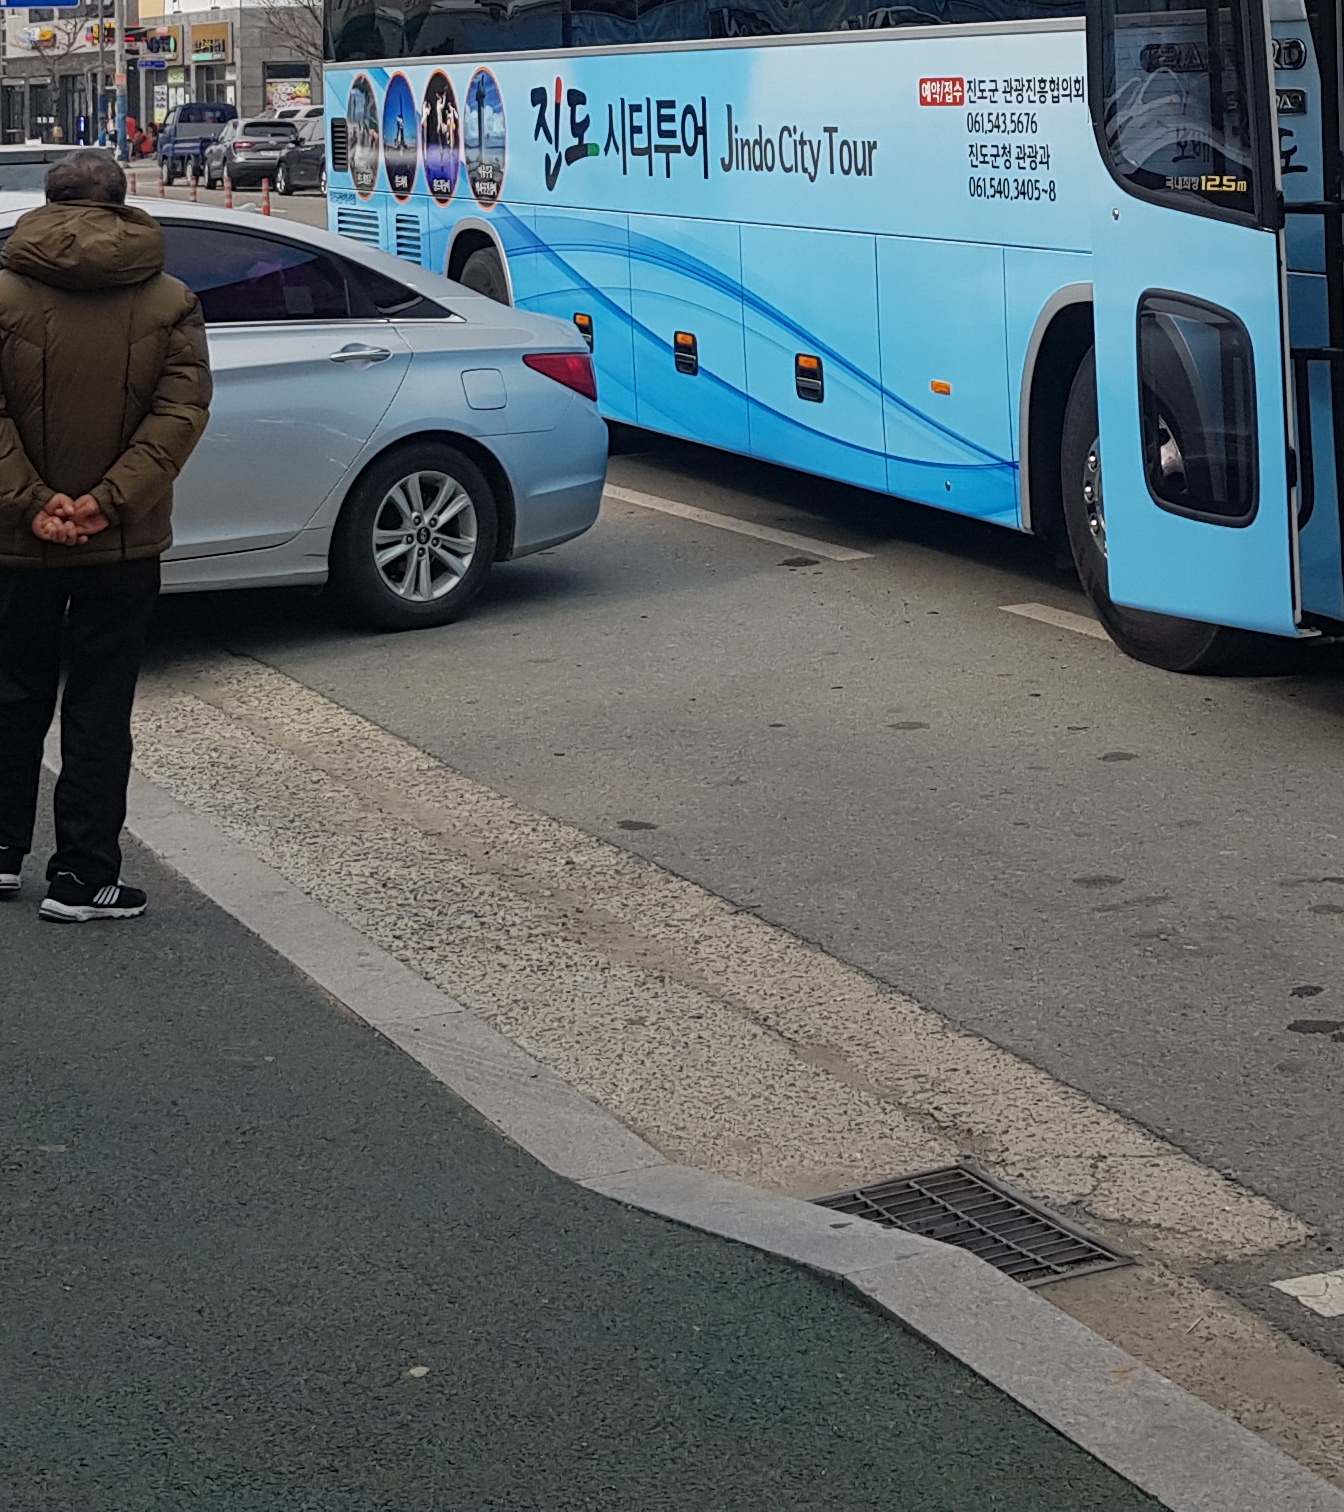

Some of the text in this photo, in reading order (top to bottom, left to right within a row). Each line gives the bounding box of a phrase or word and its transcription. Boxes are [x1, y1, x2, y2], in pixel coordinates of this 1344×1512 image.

[921, 76, 1085, 104] 예약/접수 진도군 관광진흥협의회
[530, 76, 709, 191] 진도 시티투어
[720, 104, 878, 182] Jindo City Tour
[968, 143, 1051, 170] 진도군청 관광과
[1200, 175, 1247, 192] 12.5m
